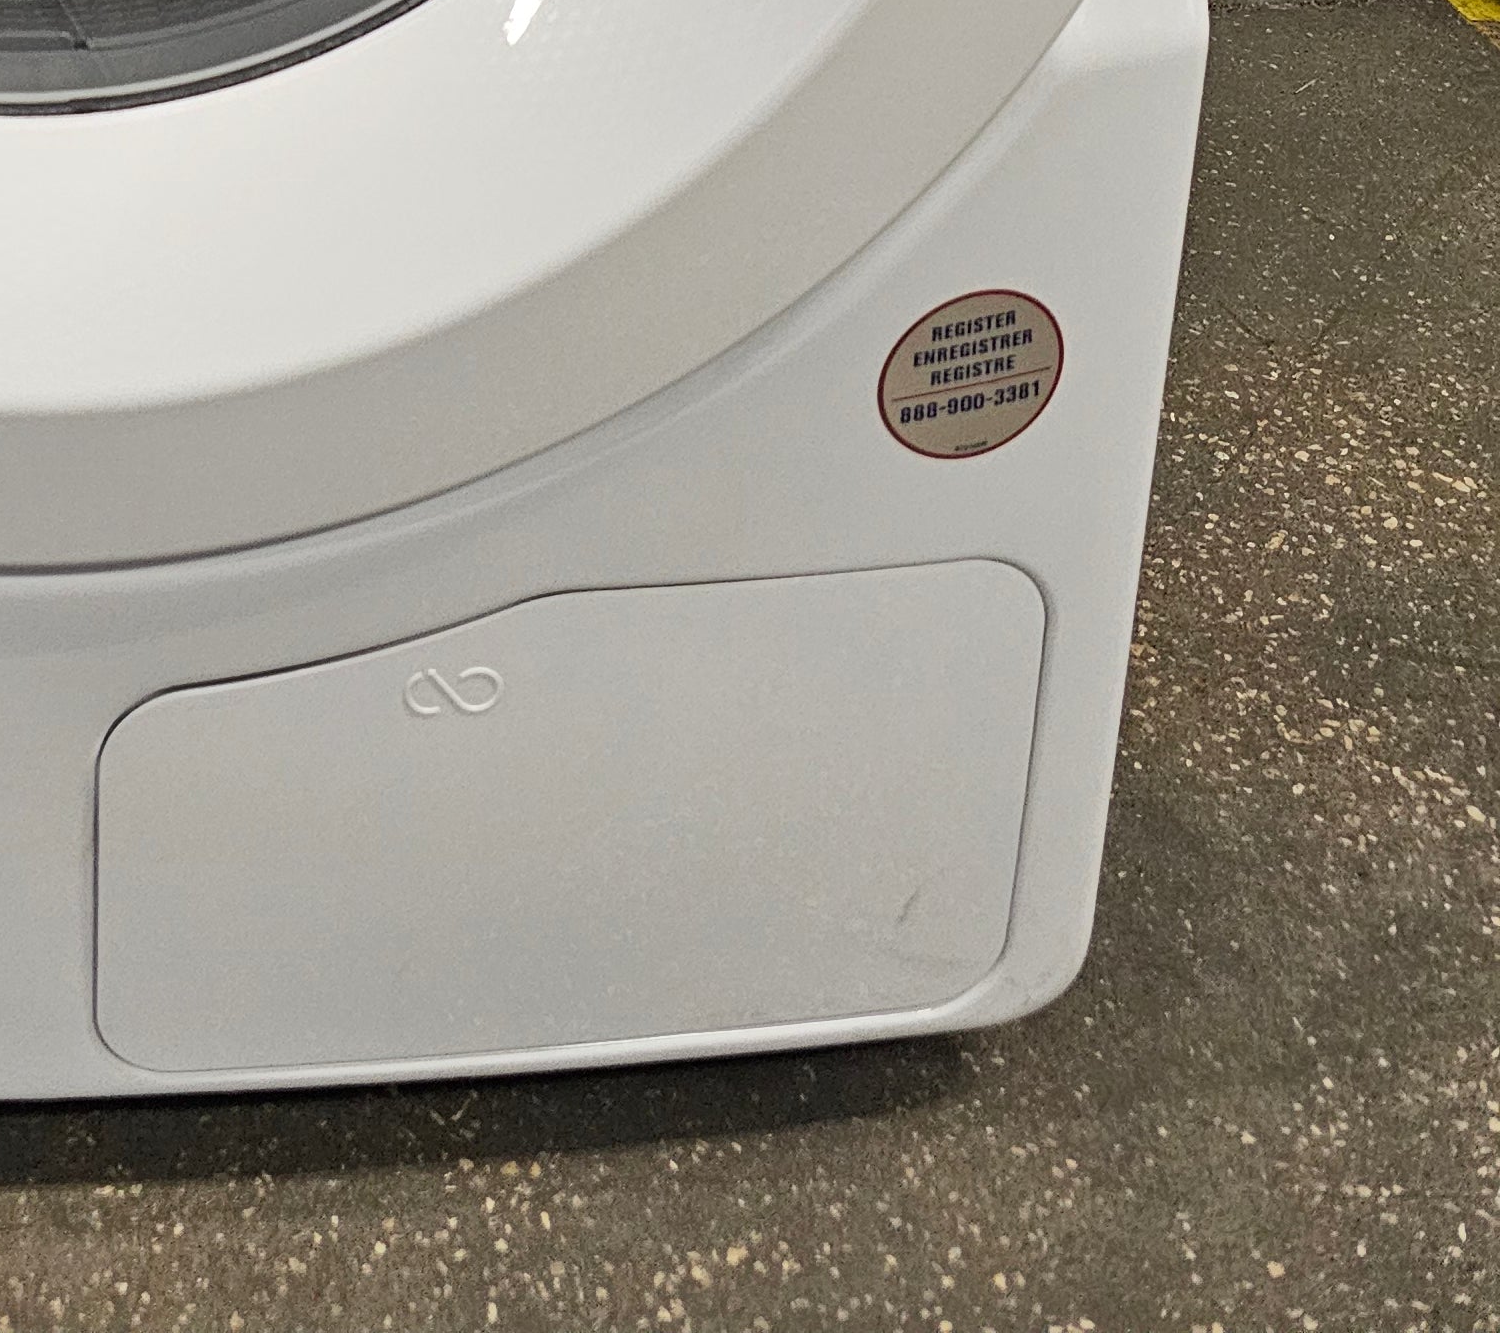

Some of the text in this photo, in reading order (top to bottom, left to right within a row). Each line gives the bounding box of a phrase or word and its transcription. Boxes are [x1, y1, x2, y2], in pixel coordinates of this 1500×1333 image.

[931, 309, 1017, 342] REGISTER
[913, 328, 1034, 368] ENREGISTRER
[930, 354, 1018, 387] REGISTRE
[900, 380, 1041, 425] 888-900-3381
